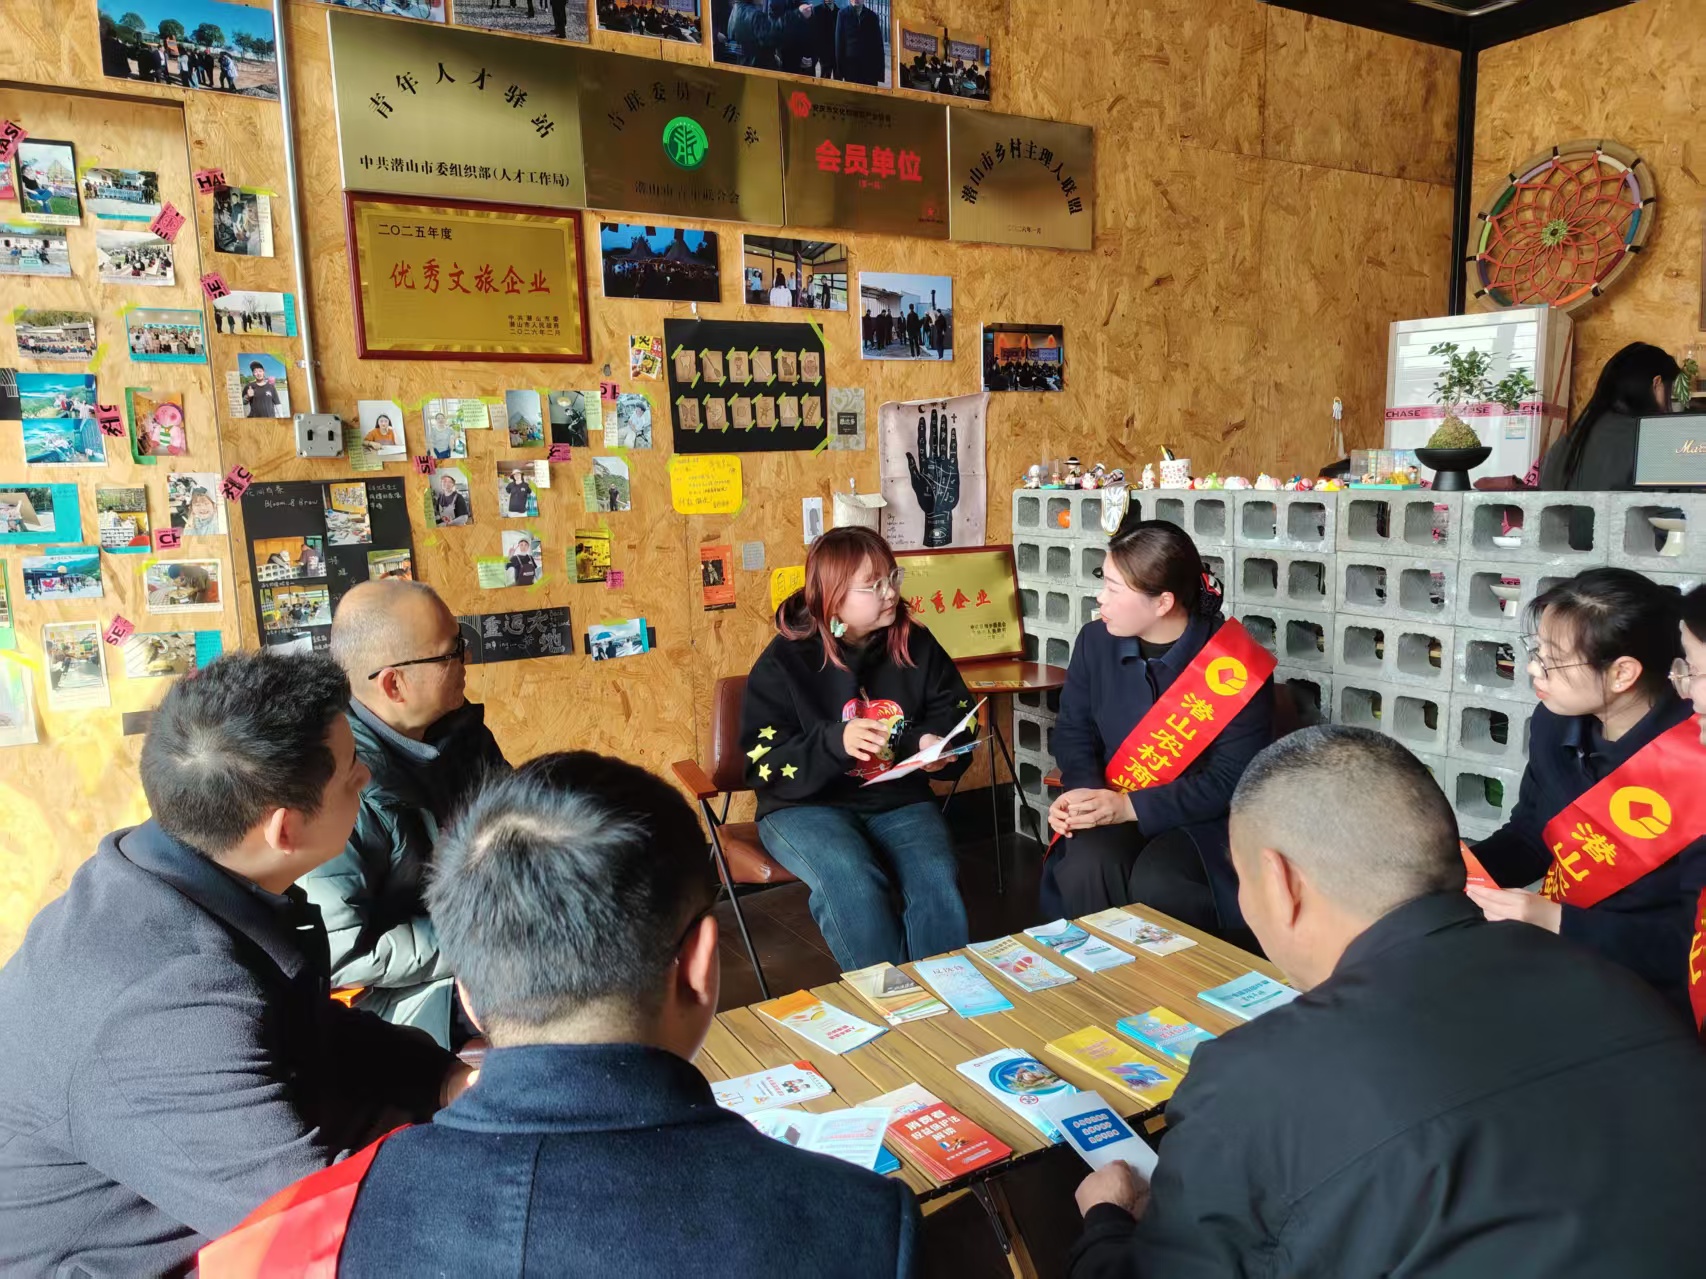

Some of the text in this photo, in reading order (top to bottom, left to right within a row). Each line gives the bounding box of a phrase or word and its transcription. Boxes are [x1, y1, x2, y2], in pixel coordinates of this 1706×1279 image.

[368, 62, 555, 138] 青年人才驿站
[359, 154, 571, 188] 中共潜山市委组织部(人才工作局)
[815, 139, 923, 183] 会员单位
[961, 137, 1083, 216] 潜山市乡村主理人联盟
[389, 257, 551, 296] 优秀文旅企业
[1386, 409, 1422, 419] CHASE
